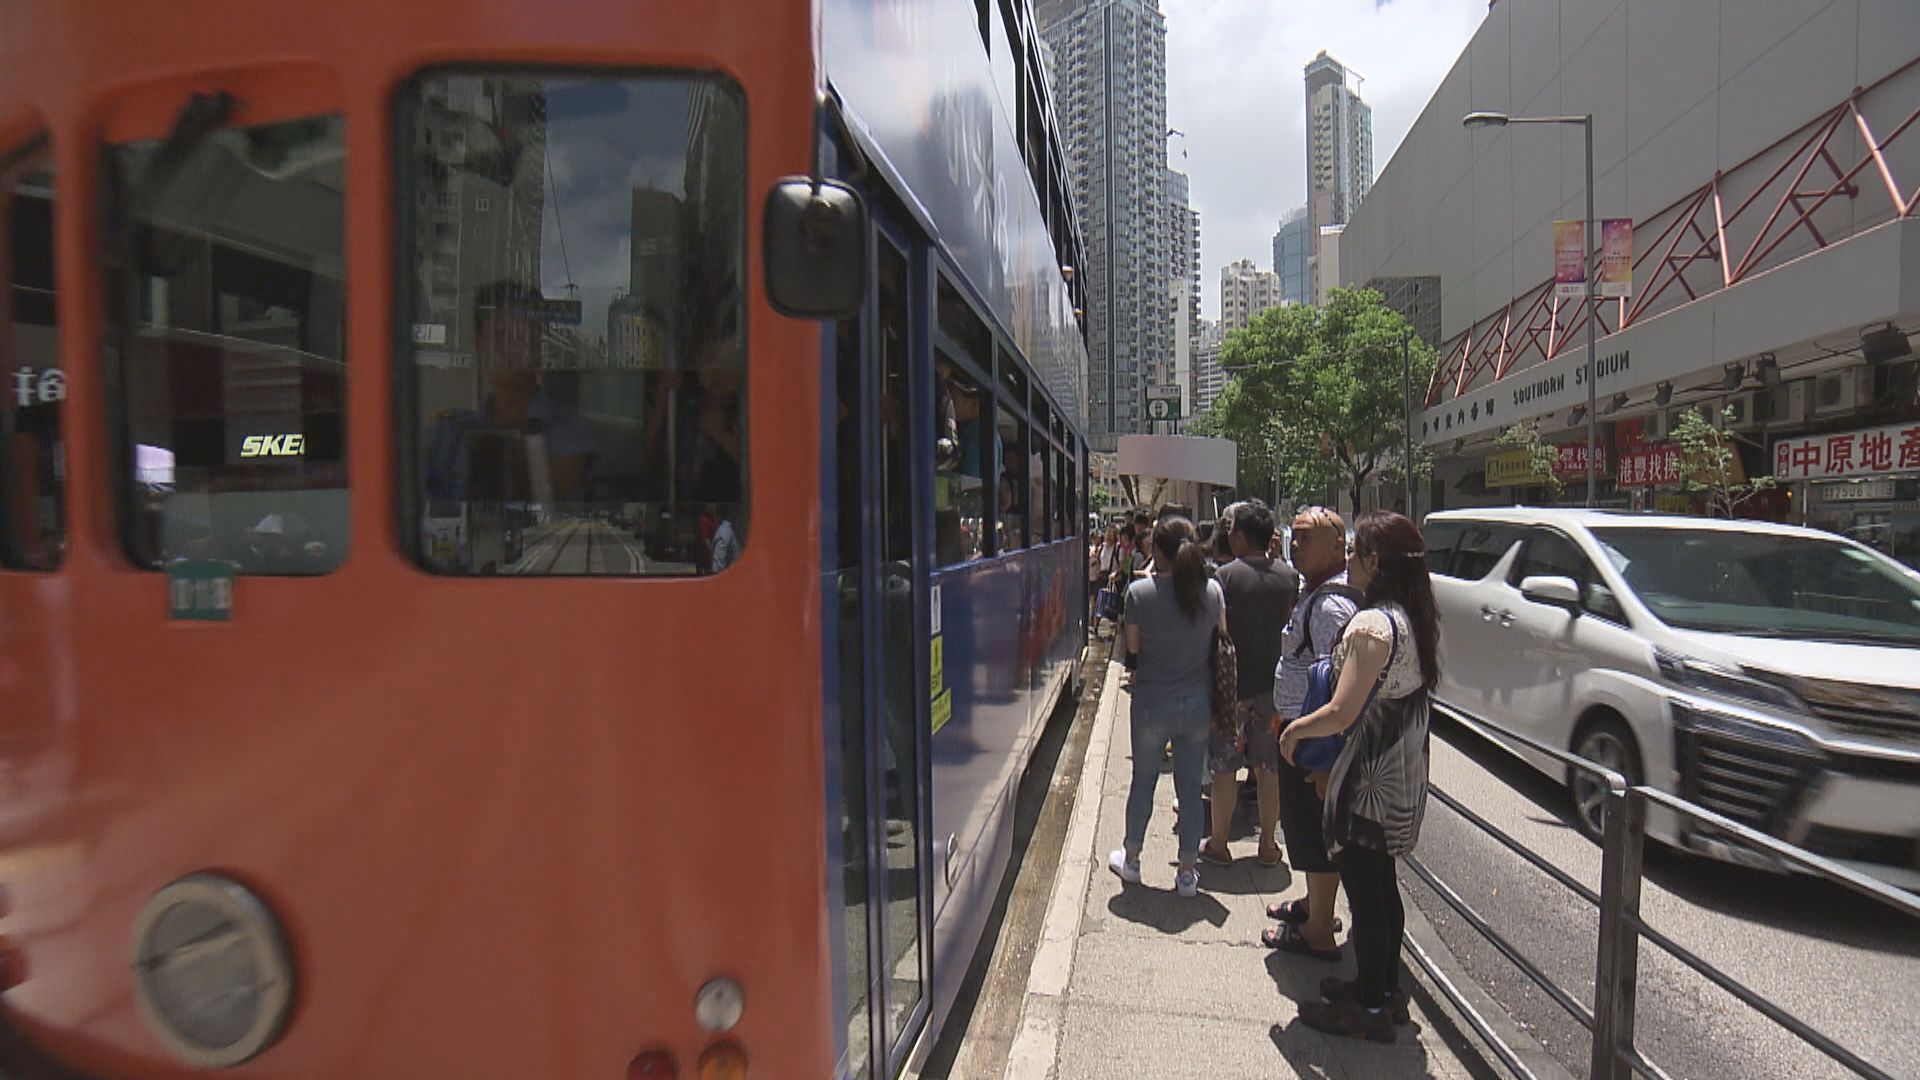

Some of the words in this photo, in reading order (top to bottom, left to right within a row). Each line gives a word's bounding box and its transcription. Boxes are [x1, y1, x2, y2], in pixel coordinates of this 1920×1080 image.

[1513, 373, 1565, 406] SOUTHORN
[1575, 350, 1630, 386] STDIUM
[1619, 451, 1678, 484] 港豐找換
[1792, 426, 1920, 477] 中原地產
